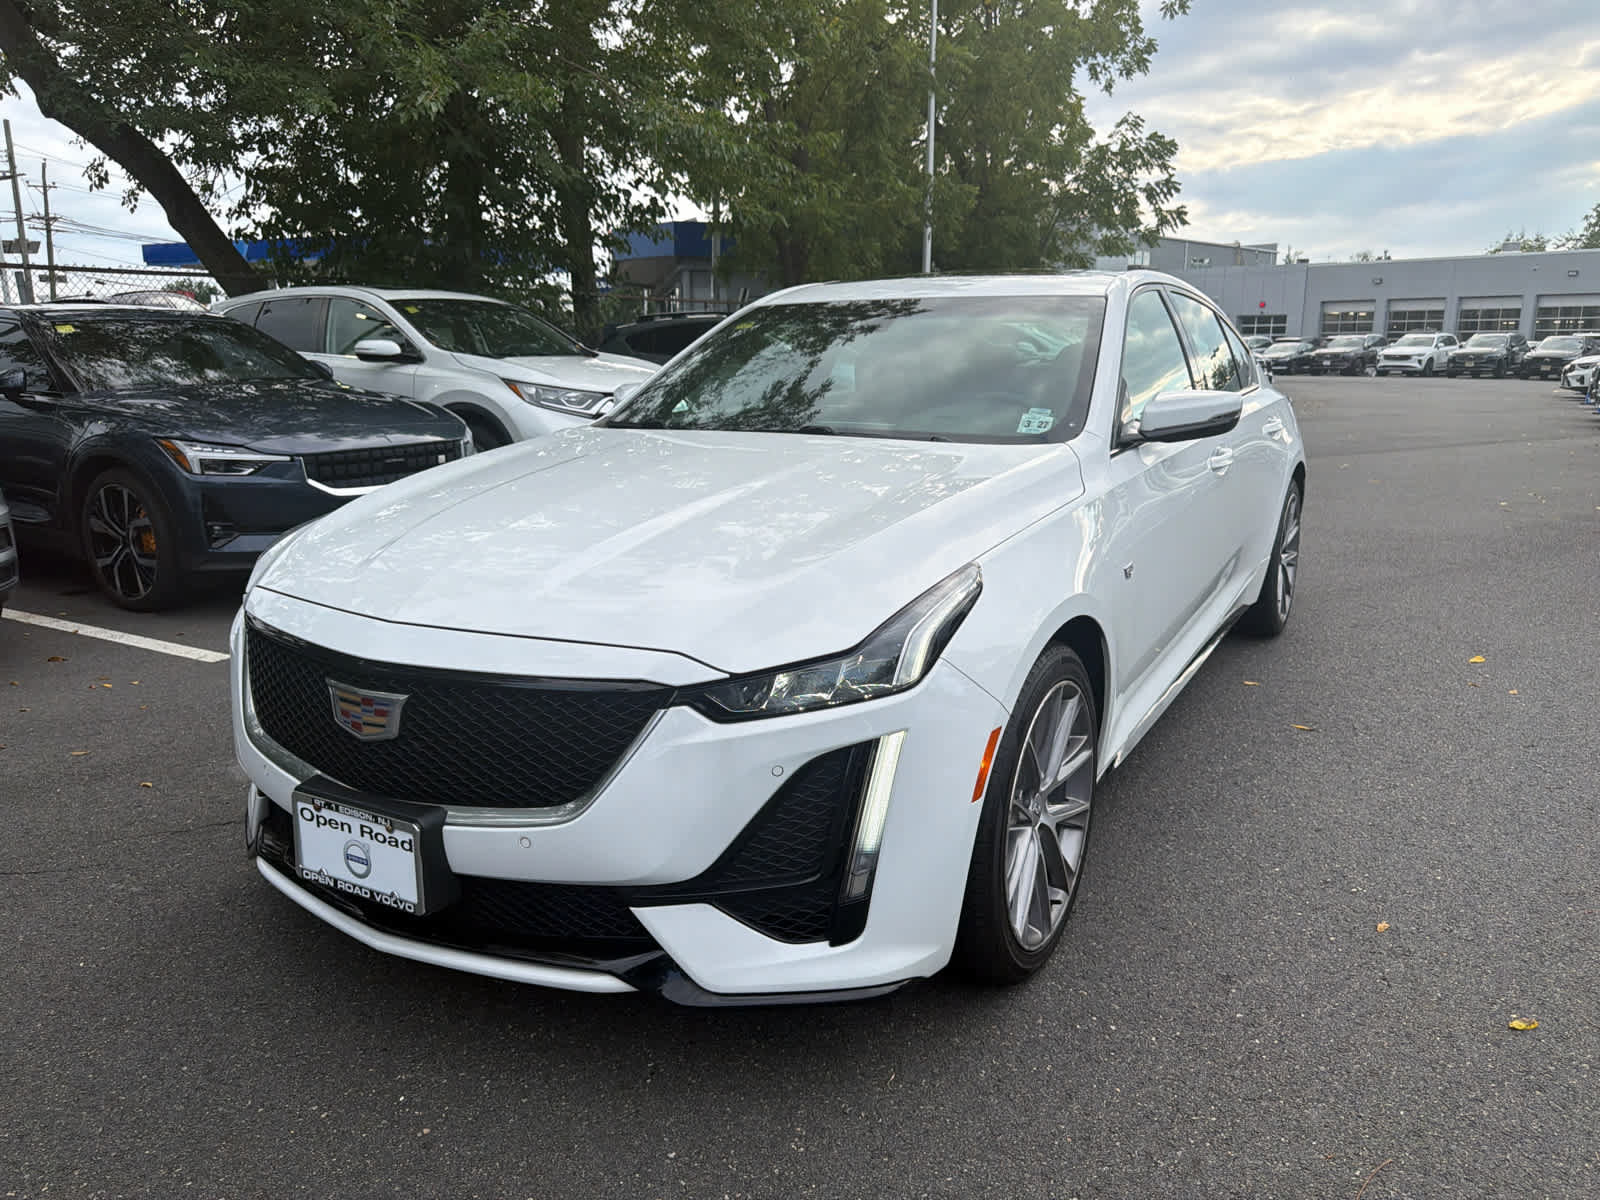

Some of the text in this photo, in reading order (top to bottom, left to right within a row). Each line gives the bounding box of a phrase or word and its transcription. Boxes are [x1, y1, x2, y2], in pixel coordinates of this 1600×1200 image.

[300, 807, 414, 852] Open Road
[302, 869, 415, 913] OPEN ROAD VOLVO
